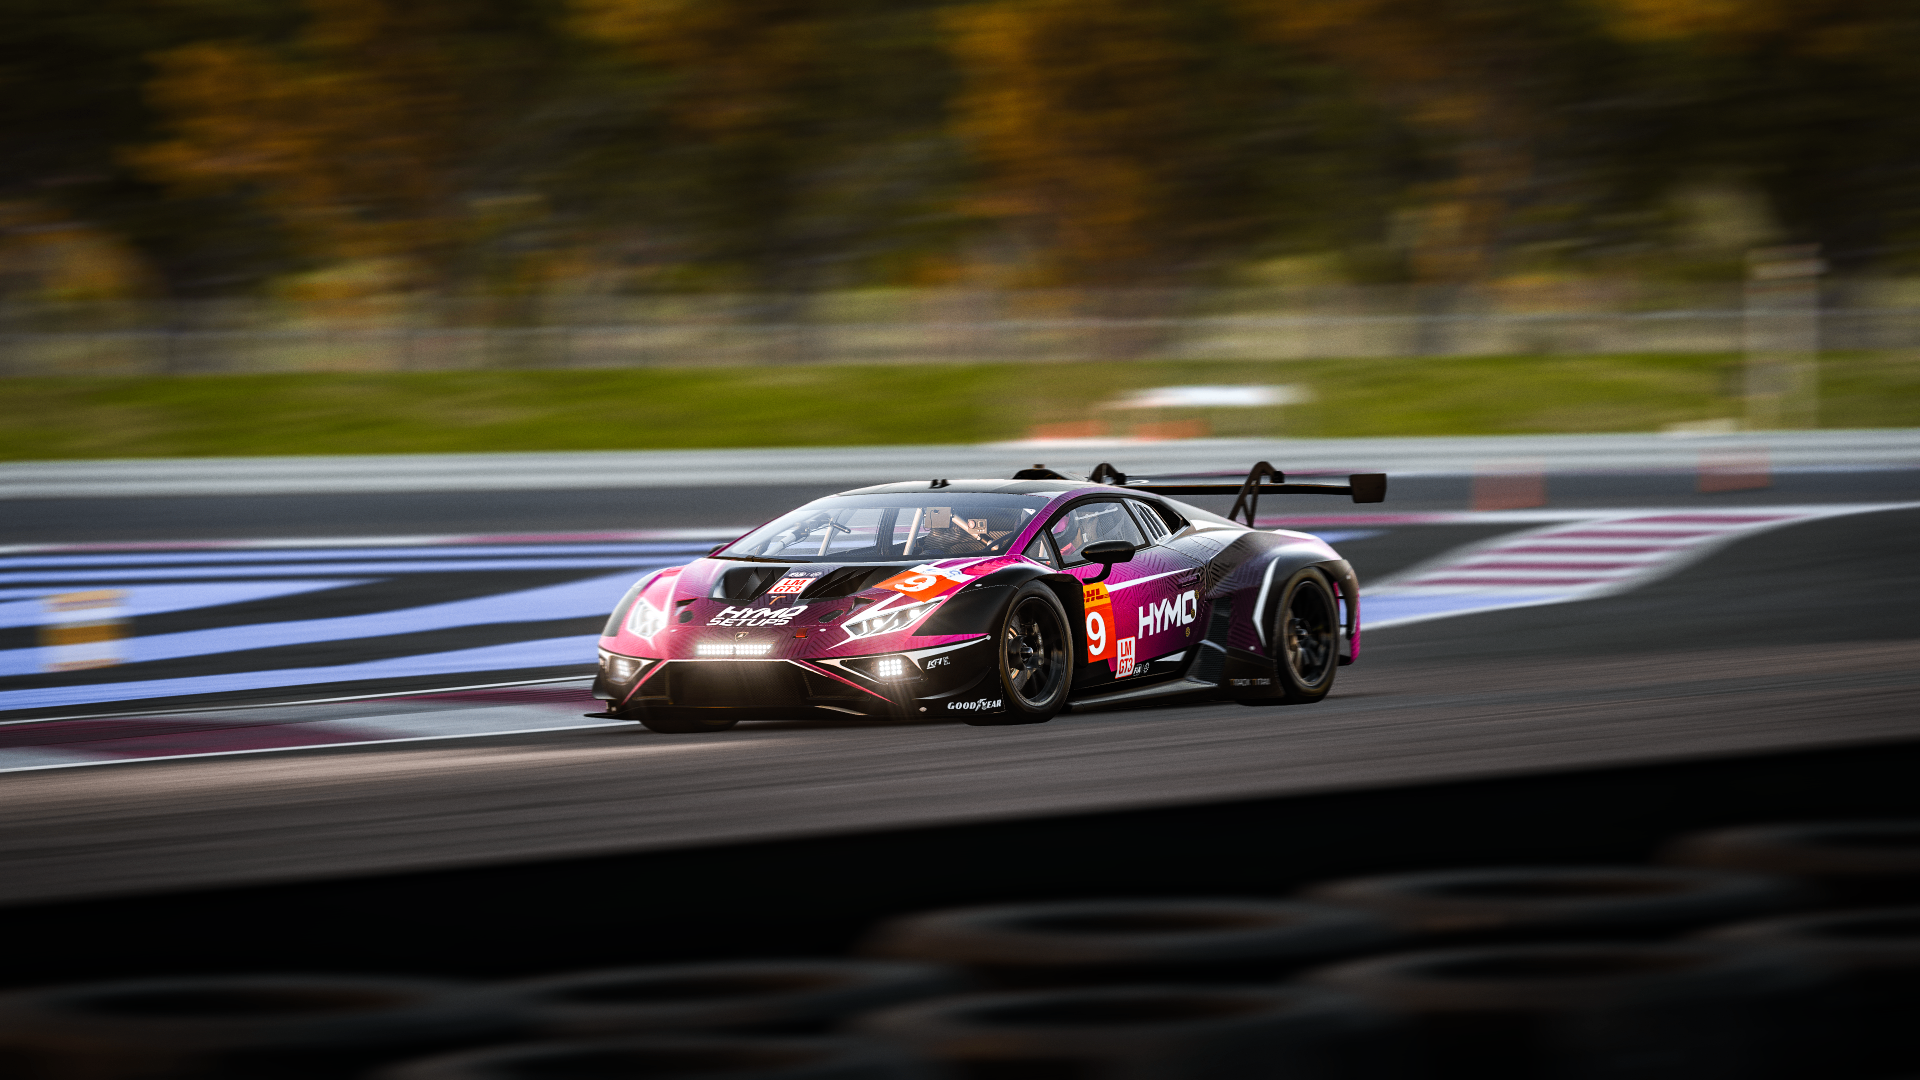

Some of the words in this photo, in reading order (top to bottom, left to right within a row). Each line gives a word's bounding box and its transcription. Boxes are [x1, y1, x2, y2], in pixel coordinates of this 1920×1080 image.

[894, 574, 937, 592] 9
[1083, 588, 1104, 603] HL
[716, 605, 808, 619] HYMO
[1138, 589, 1197, 640] HYMO
[706, 617, 793, 626] SETUPS
[1086, 611, 1106, 656] 9
[1118, 657, 1133, 675] GT3
[947, 698, 1002, 711] GOODYEAR
